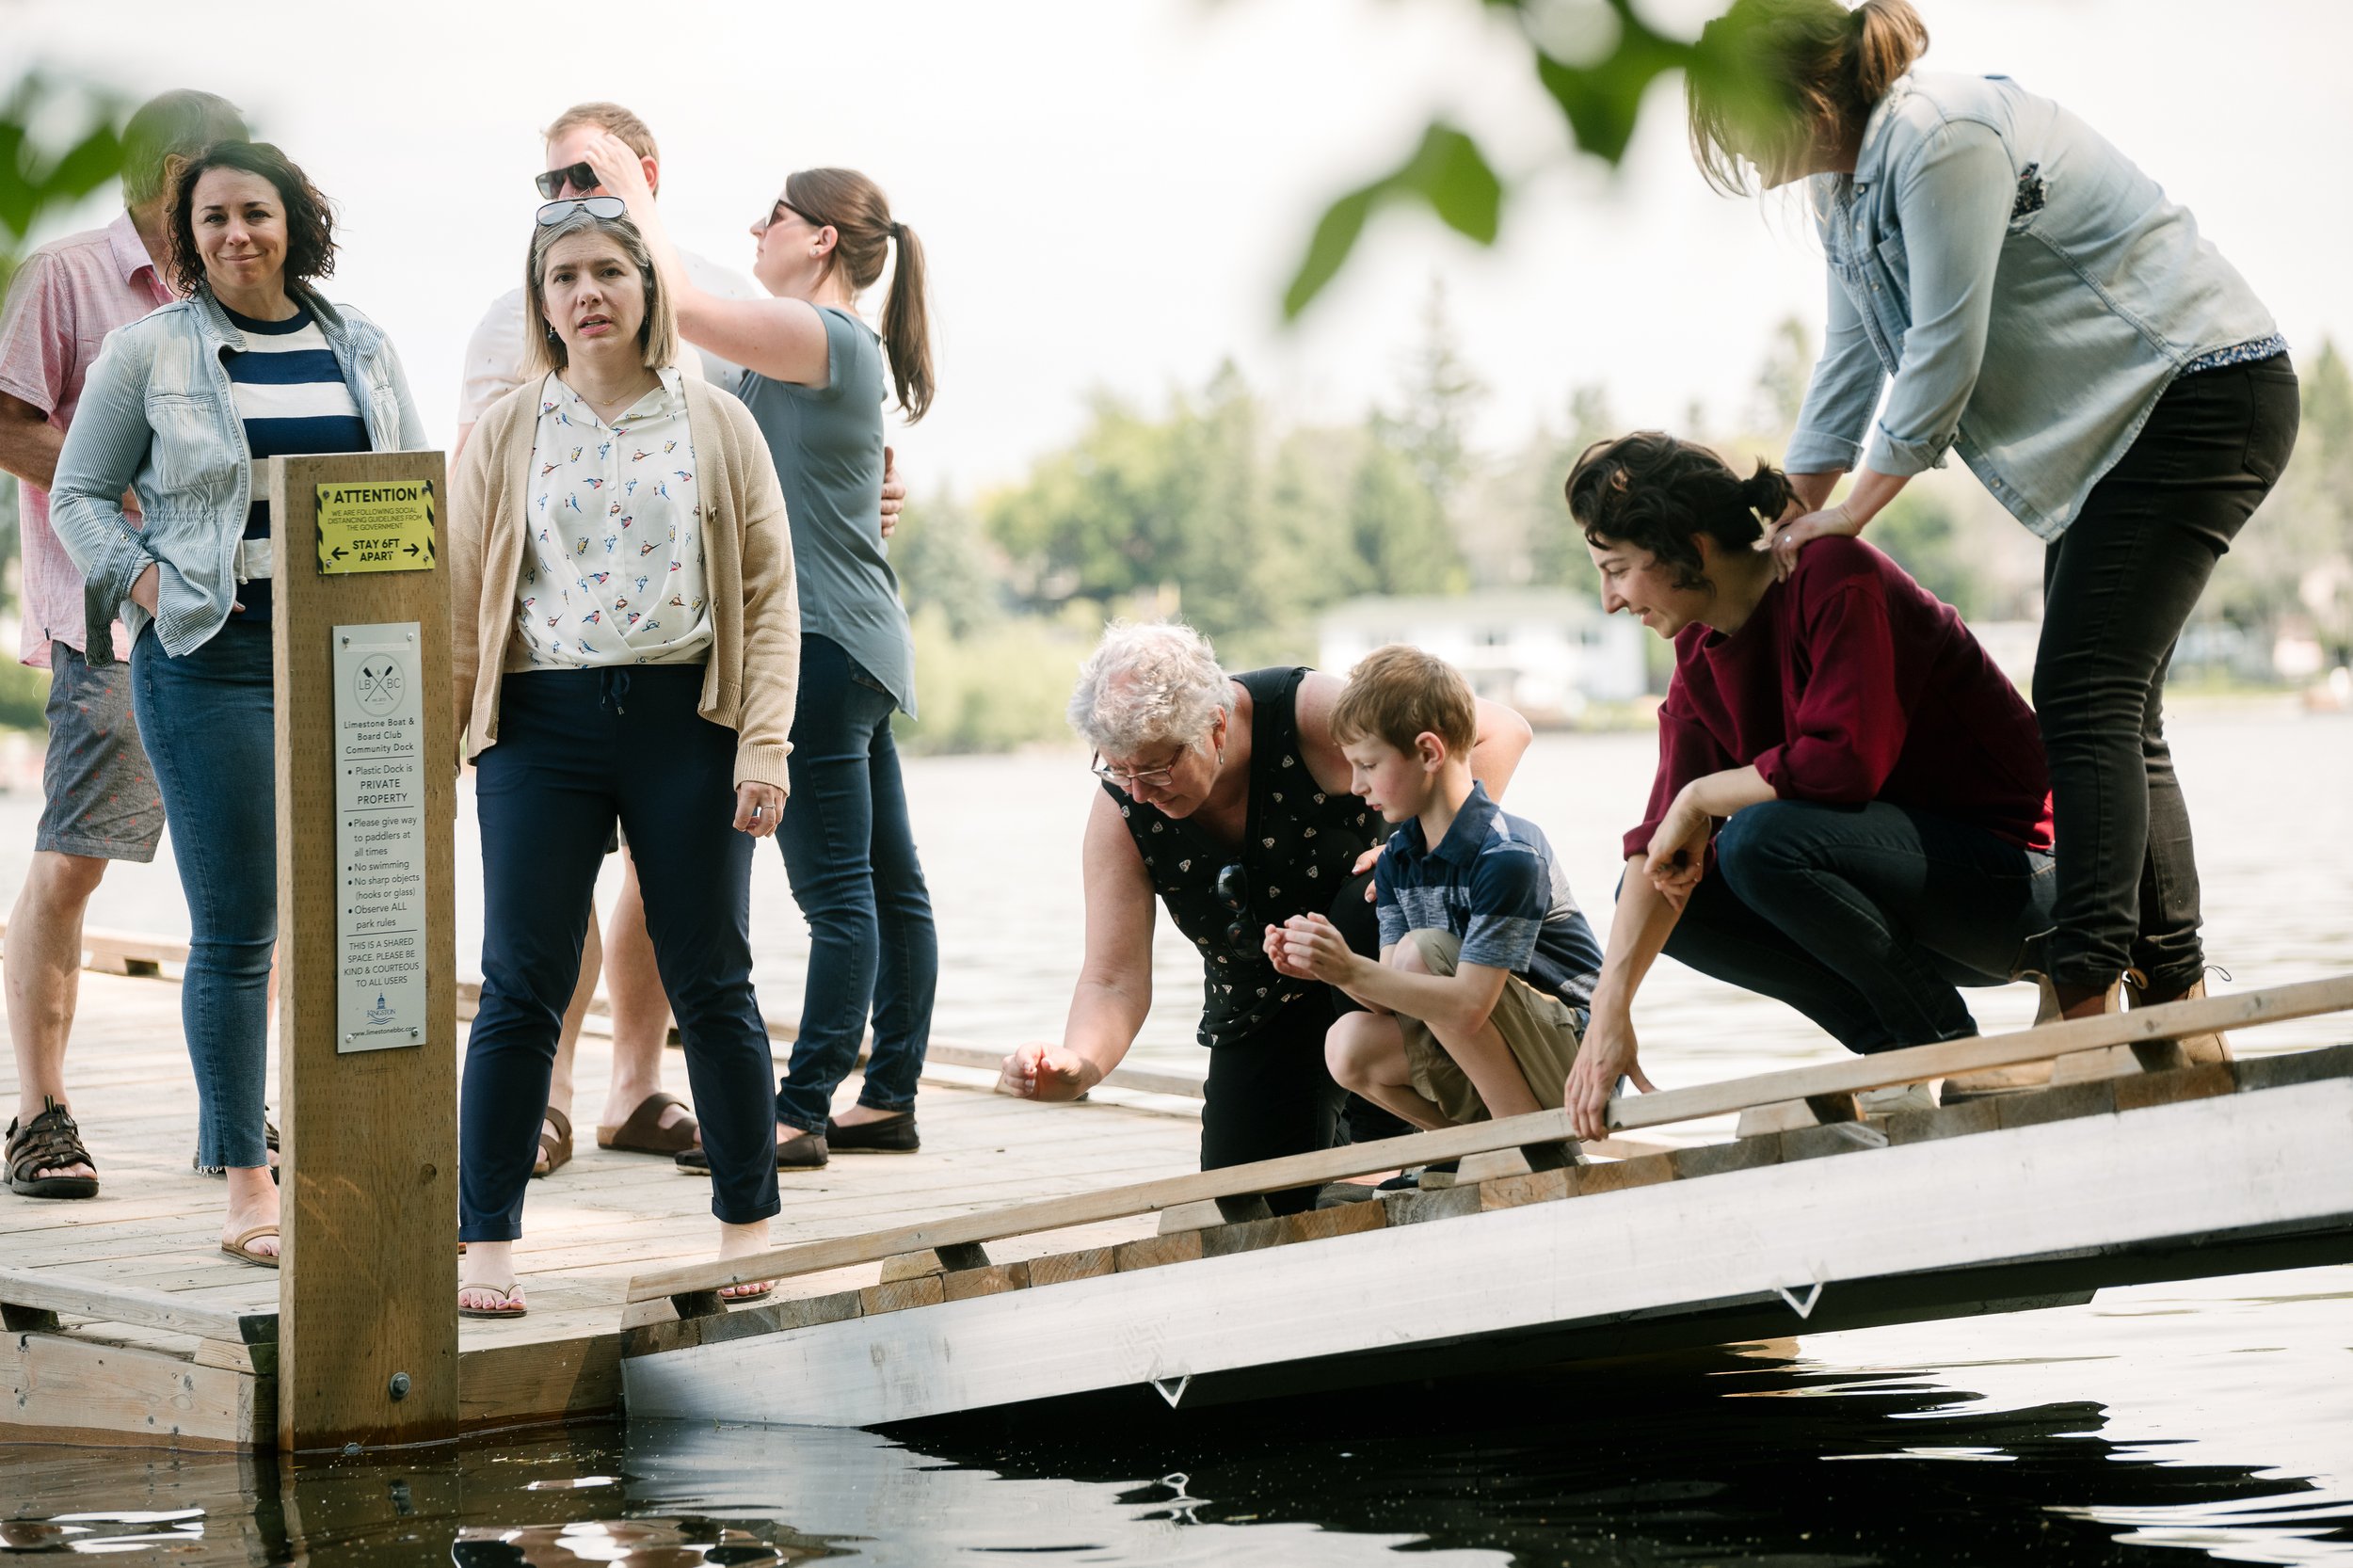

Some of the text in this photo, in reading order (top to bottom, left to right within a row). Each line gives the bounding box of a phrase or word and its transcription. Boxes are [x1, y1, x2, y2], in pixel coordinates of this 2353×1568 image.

[334, 488, 417, 504] ATTENTION
[344, 508, 356, 516] ARE
[358, 508, 393, 516] FOLLOWING
[328, 517, 367, 525] DISTANCING
[368, 515, 404, 523] GUIDELINES
[353, 538, 400, 550] STAY 6FT
[360, 551, 394, 562] APART
[359, 678, 401, 690] LB BC
[344, 717, 415, 729] Limestone Boat &
[358, 730, 402, 741] Board Club
[346, 743, 414, 754] Community Dock
[355, 763, 413, 775] Plastic Dock is
[360, 779, 401, 790] PRIVATE
[358, 792, 408, 805] PROPERTY
[354, 816, 417, 828] Please give way
[365, 831, 400, 844] paddlers
[354, 847, 388, 857] all times
[354, 860, 409, 872] No swimming
[354, 874, 420, 886] No sharp objects
[356, 890, 381, 901] (hooks
[393, 887, 416, 899] glass)
[354, 902, 407, 914] Observe ALL
[356, 918, 396, 932] park rules
[349, 941, 366, 950] THIS
[368, 941, 374, 949] IS
[384, 937, 414, 948] SHARED
[348, 950, 416, 963] SPACE. PLEASE BE
[344, 962, 419, 976] KIND & COURTEOUS
[356, 976, 408, 987] TO ALL USERS
[367, 1008, 396, 1017] KINGSTON
